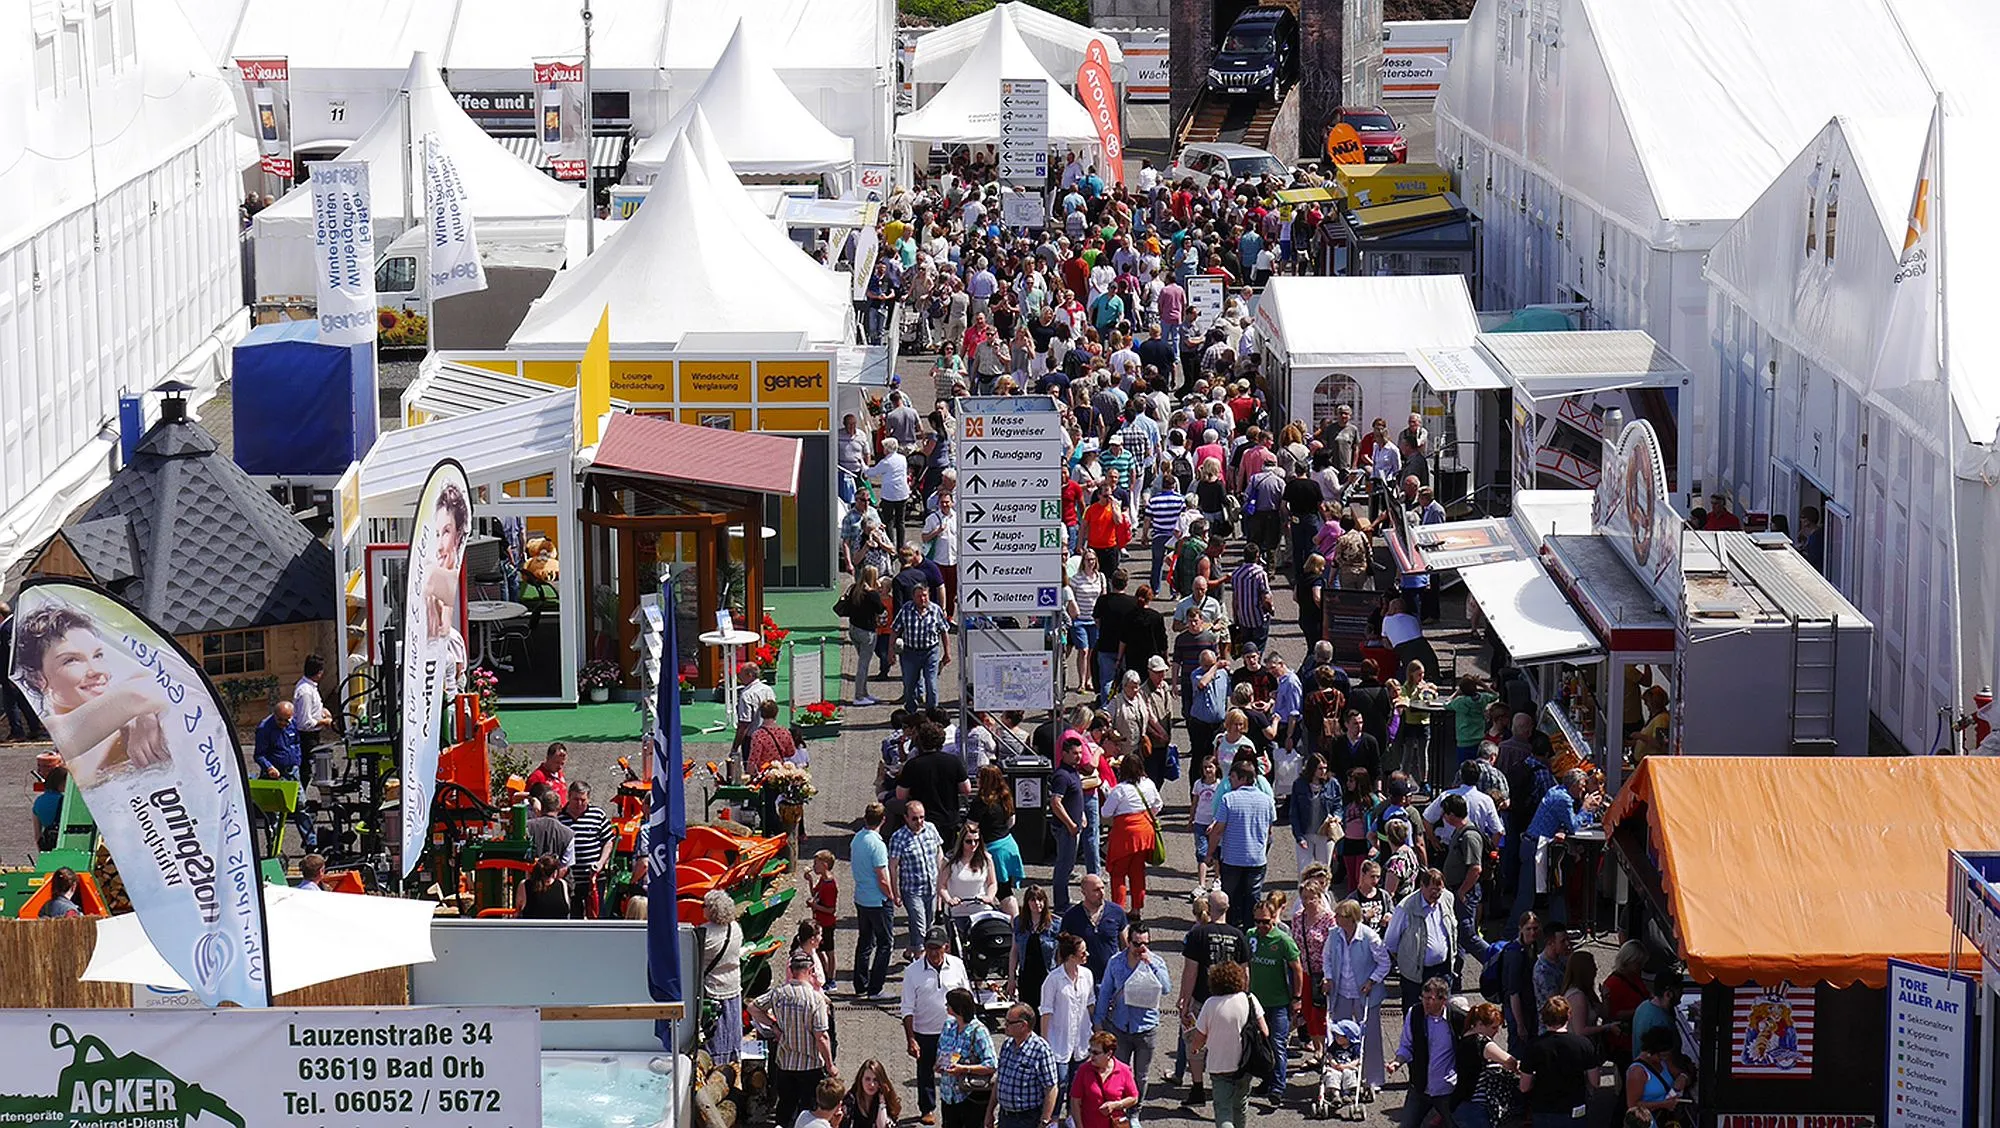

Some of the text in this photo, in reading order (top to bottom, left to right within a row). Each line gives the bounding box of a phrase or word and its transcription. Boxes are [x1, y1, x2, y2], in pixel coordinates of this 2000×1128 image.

[494, 94, 524, 109] und
[330, 108, 345, 121] 11
[326, 192, 342, 289] Wintergärten
[622, 372, 652, 383] Lounge
[691, 372, 740, 381] Windschutz
[763, 373, 823, 392] genert
[610, 380, 665, 391] Überdachung
[693, 382, 739, 392] Verglasung
[991, 416, 1024, 425] Messe
[991, 427, 1045, 438] Wegweiser
[991, 450, 1042, 461] Rundgang
[991, 479, 1017, 488] Halle
[1021, 479, 1028, 488] 7
[1036, 479, 1049, 488] 20
[992, 503, 1037, 513] Ausgang
[992, 514, 1017, 523] West
[992, 531, 1025, 541] Haupt-
[992, 542, 1037, 552] Ausgang
[992, 566, 1033, 575] Festzelt
[992, 593, 1034, 602] Toiletten
[408, 634, 419, 680] Haus
[1899, 976, 1928, 994] TORE
[1898, 990, 1959, 1015] ALLER ART
[288, 1022, 493, 1047] Lauzenstraße 34
[1906, 1028, 1938, 1043] Kipptore
[1906, 1041, 1950, 1060] Schwingtore
[299, 1055, 485, 1080] 63619 Bad Orb
[1906, 1055, 1935, 1070] Rolltore
[1905, 1067, 1947, 1087] Schiebetore
[70, 1079, 177, 1114] ACKER
[1905, 1081, 1938, 1098] Drehtore
[283, 1089, 501, 1115] Tel. 06052 / 5672
